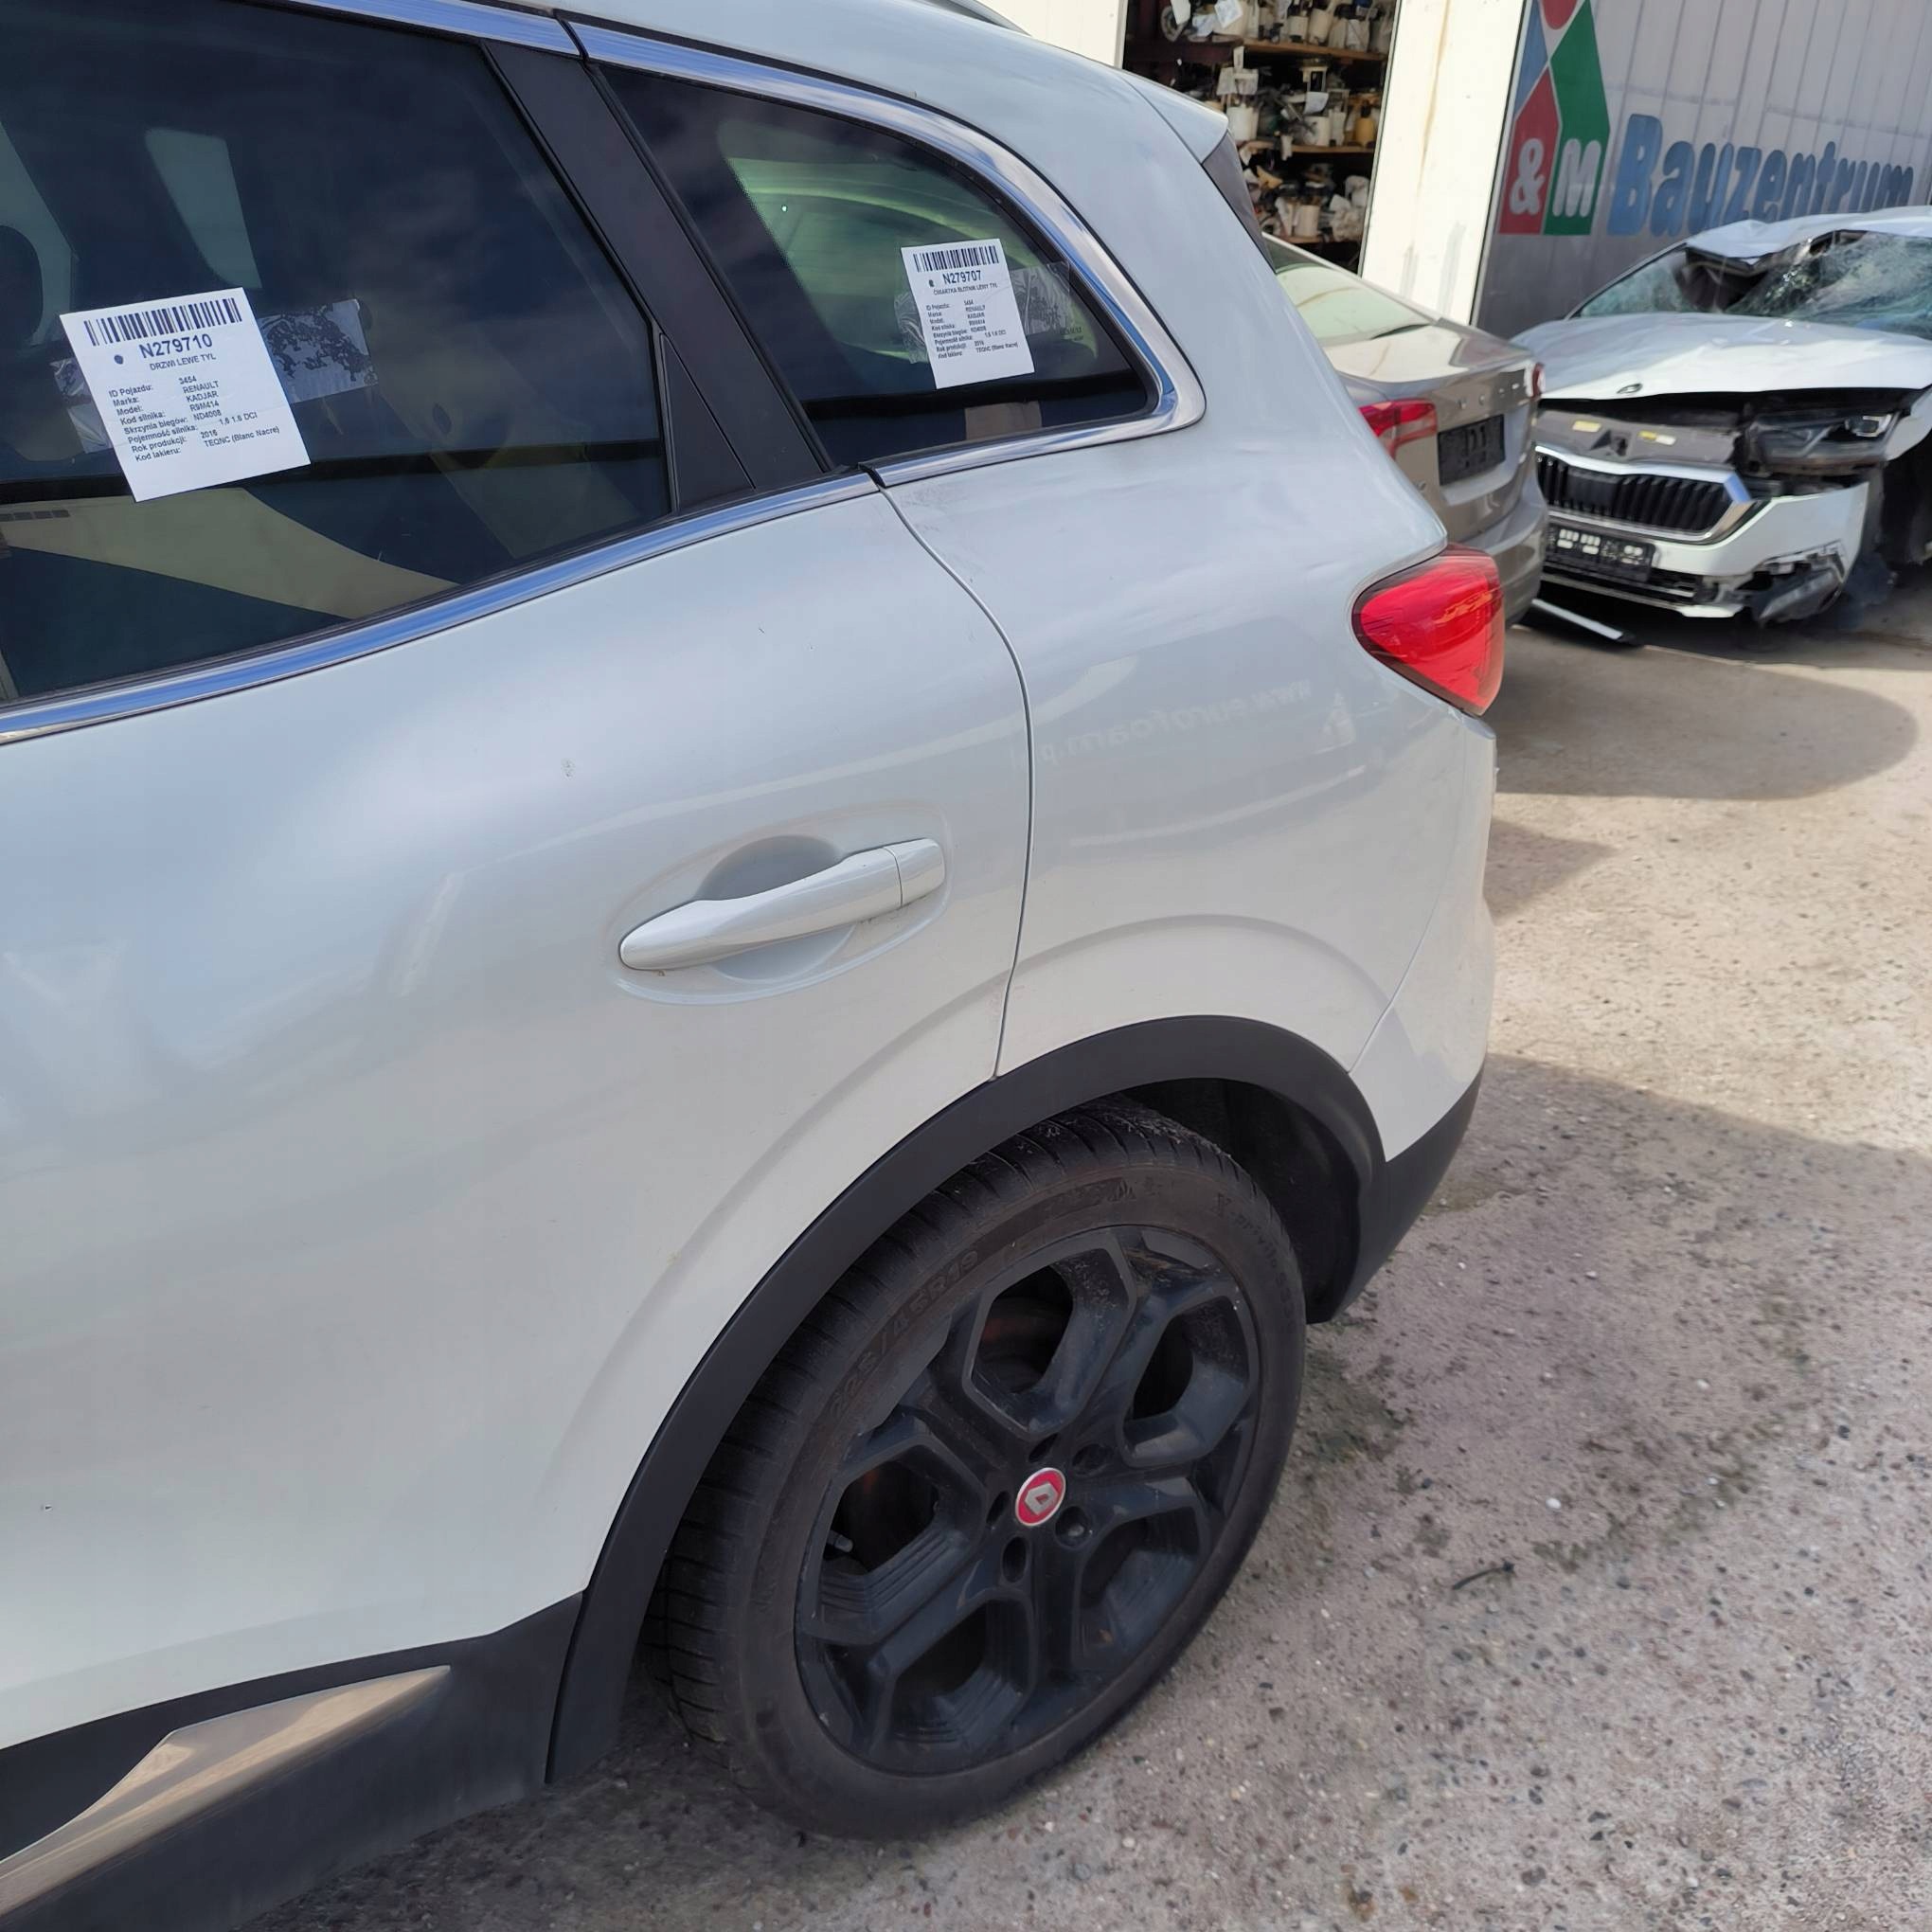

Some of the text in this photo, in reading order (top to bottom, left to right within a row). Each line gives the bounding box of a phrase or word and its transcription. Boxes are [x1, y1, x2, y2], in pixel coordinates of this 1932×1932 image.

[1607, 113, 1914, 238] Bauzentrum
[942, 270, 981, 284] N279707
[138, 333, 213, 359] N279710
[150, 361, 176, 370] DRZWI
[177, 356, 200, 366] LEWE
[109, 375, 197, 399] ID Pojazdu: 3454
[114, 381, 220, 407] Marka: RENAULT
[116, 391, 219, 416] Model: KADJAR
[120, 417, 136, 425] Kod
[189, 401, 219, 412] R9M414
[243, 412, 258, 420] DCI
[124, 423, 157, 435] Skrzynia
[135, 454, 152, 462] Kod
[152, 448, 181, 458] lakieru:
[232, 432, 255, 443] (Blanc
[256, 426, 280, 437] Nacre)
